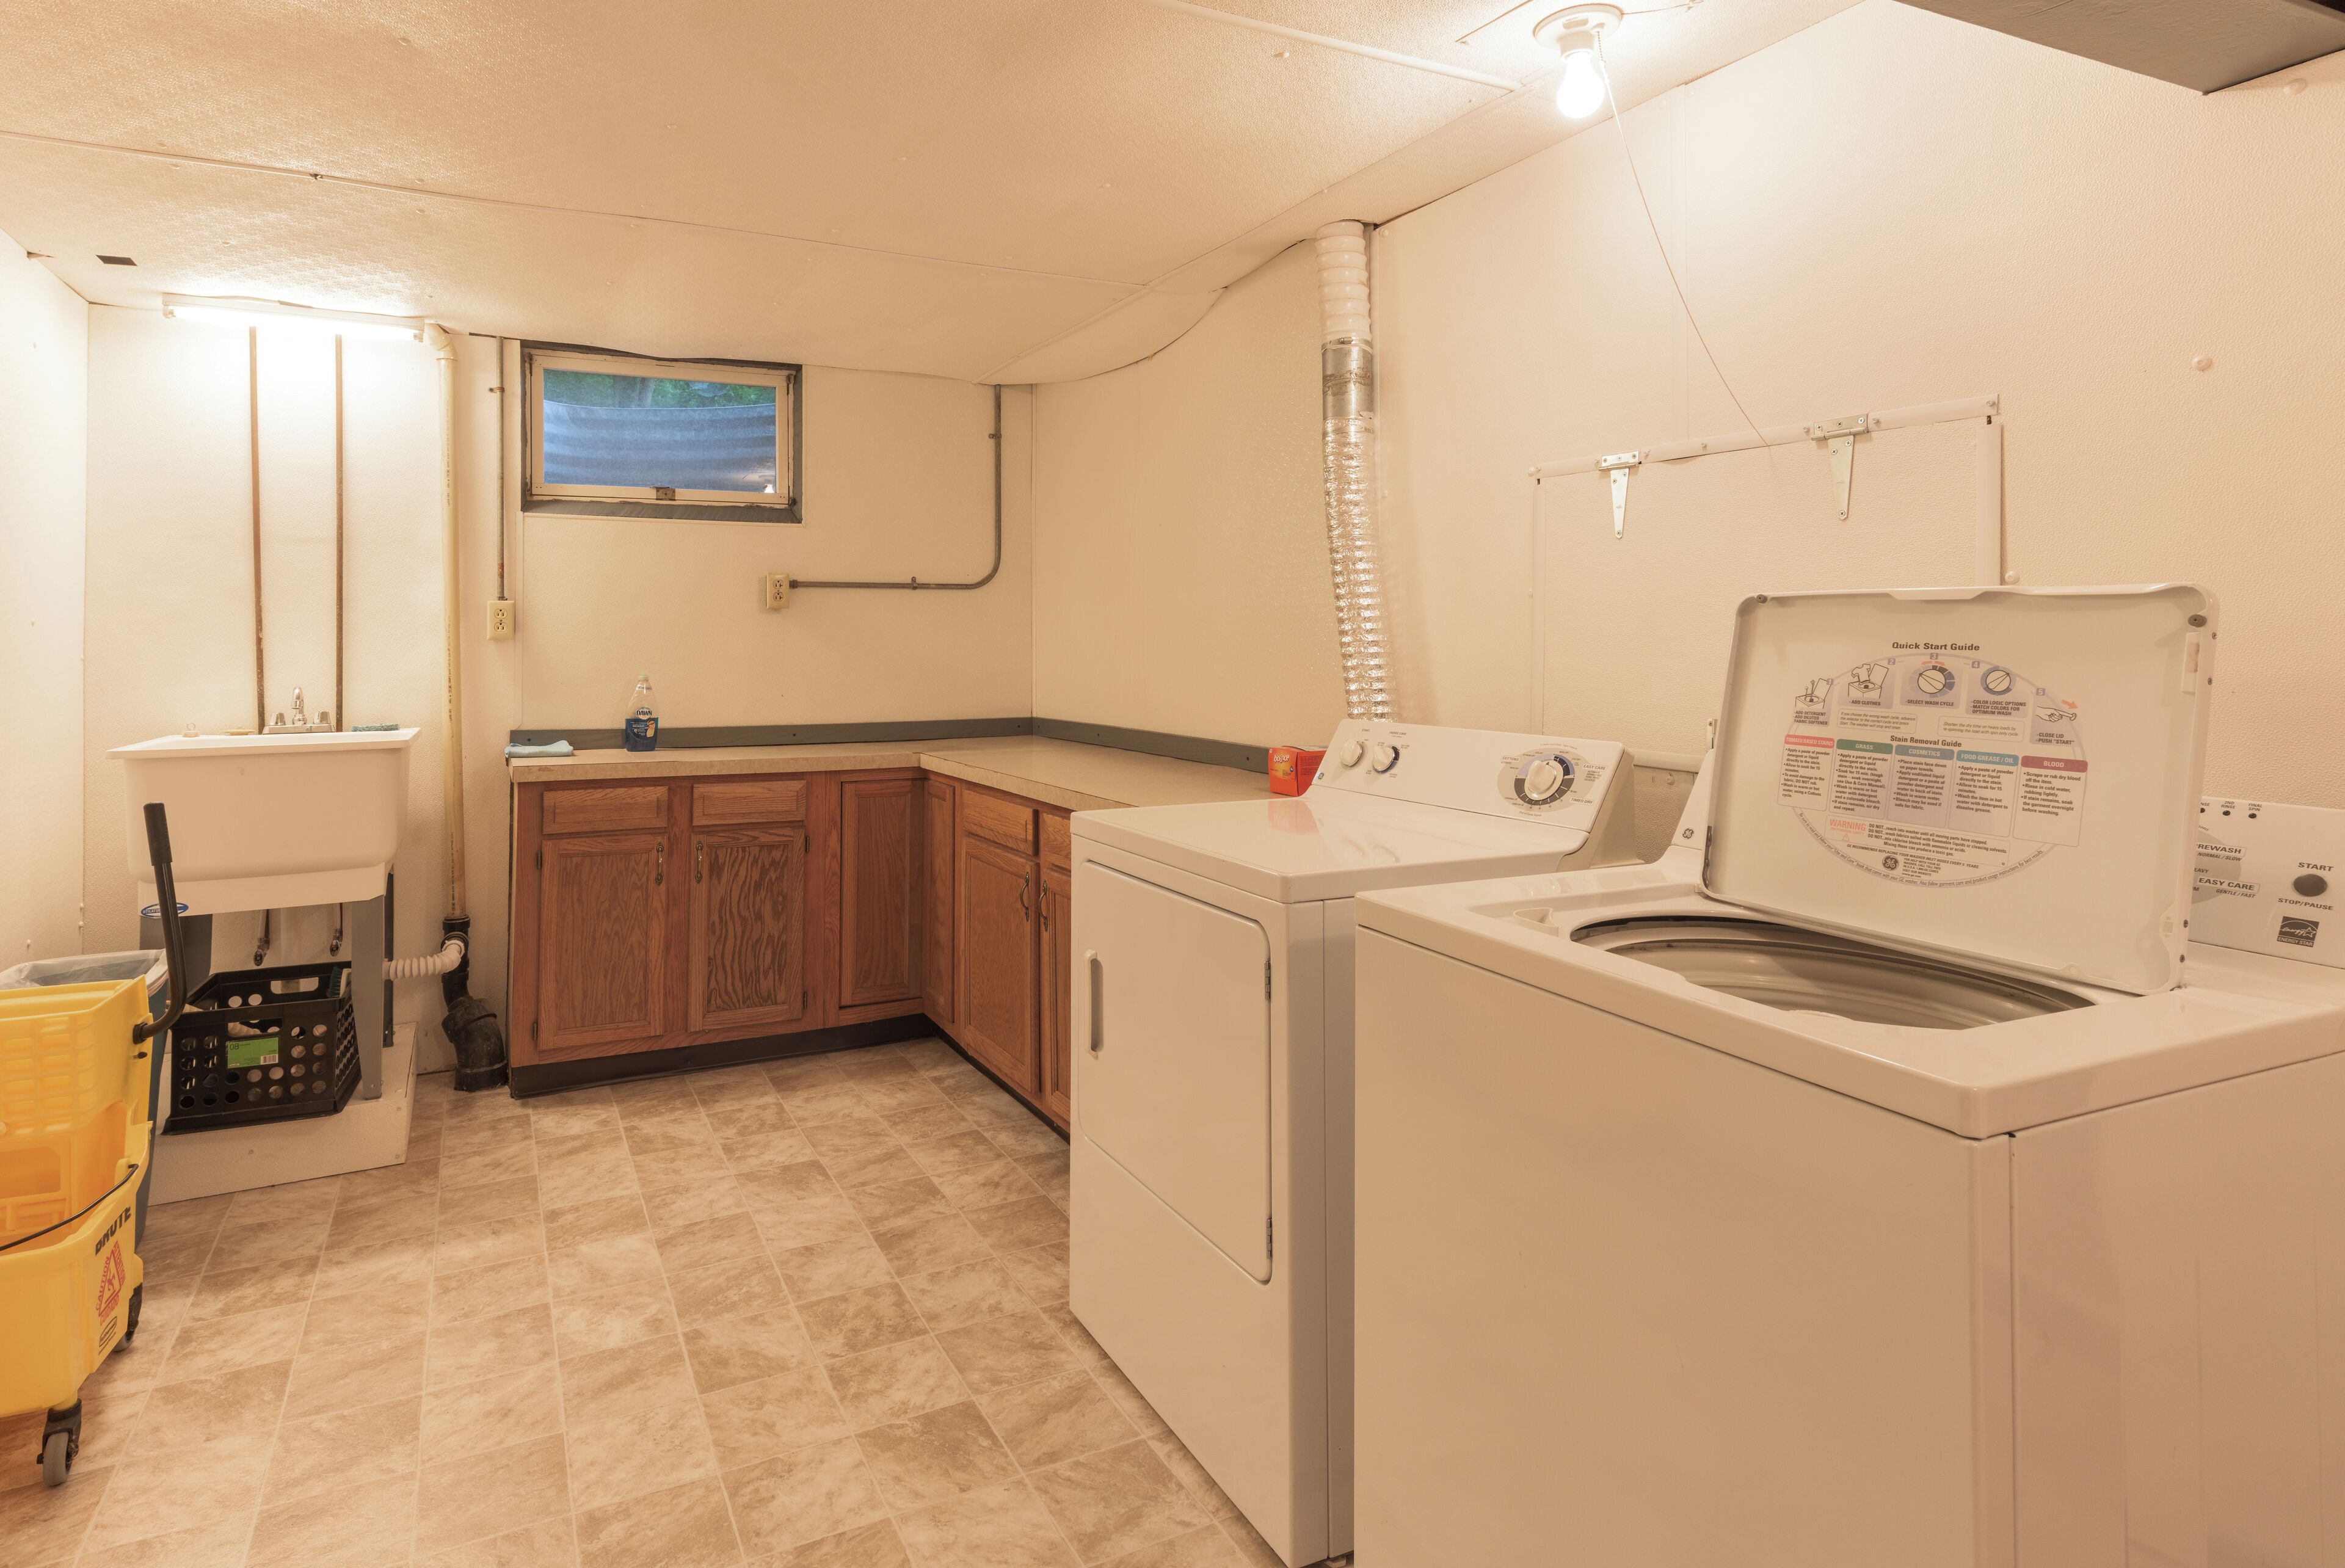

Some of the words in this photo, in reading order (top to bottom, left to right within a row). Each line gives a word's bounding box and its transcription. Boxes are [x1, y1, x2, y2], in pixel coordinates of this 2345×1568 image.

[1274, 753, 1290, 763] bounce
[1830, 819, 1866, 831] WARNING
[2197, 844, 2242, 854] REWASH
[2298, 862, 2335, 872] START
[2198, 877, 2225, 886] EASY
[2227, 882, 2255, 891] CARE
[2278, 898, 2334, 910] STOP/PAUSE
[96, 1256, 110, 1311] CAUTION
